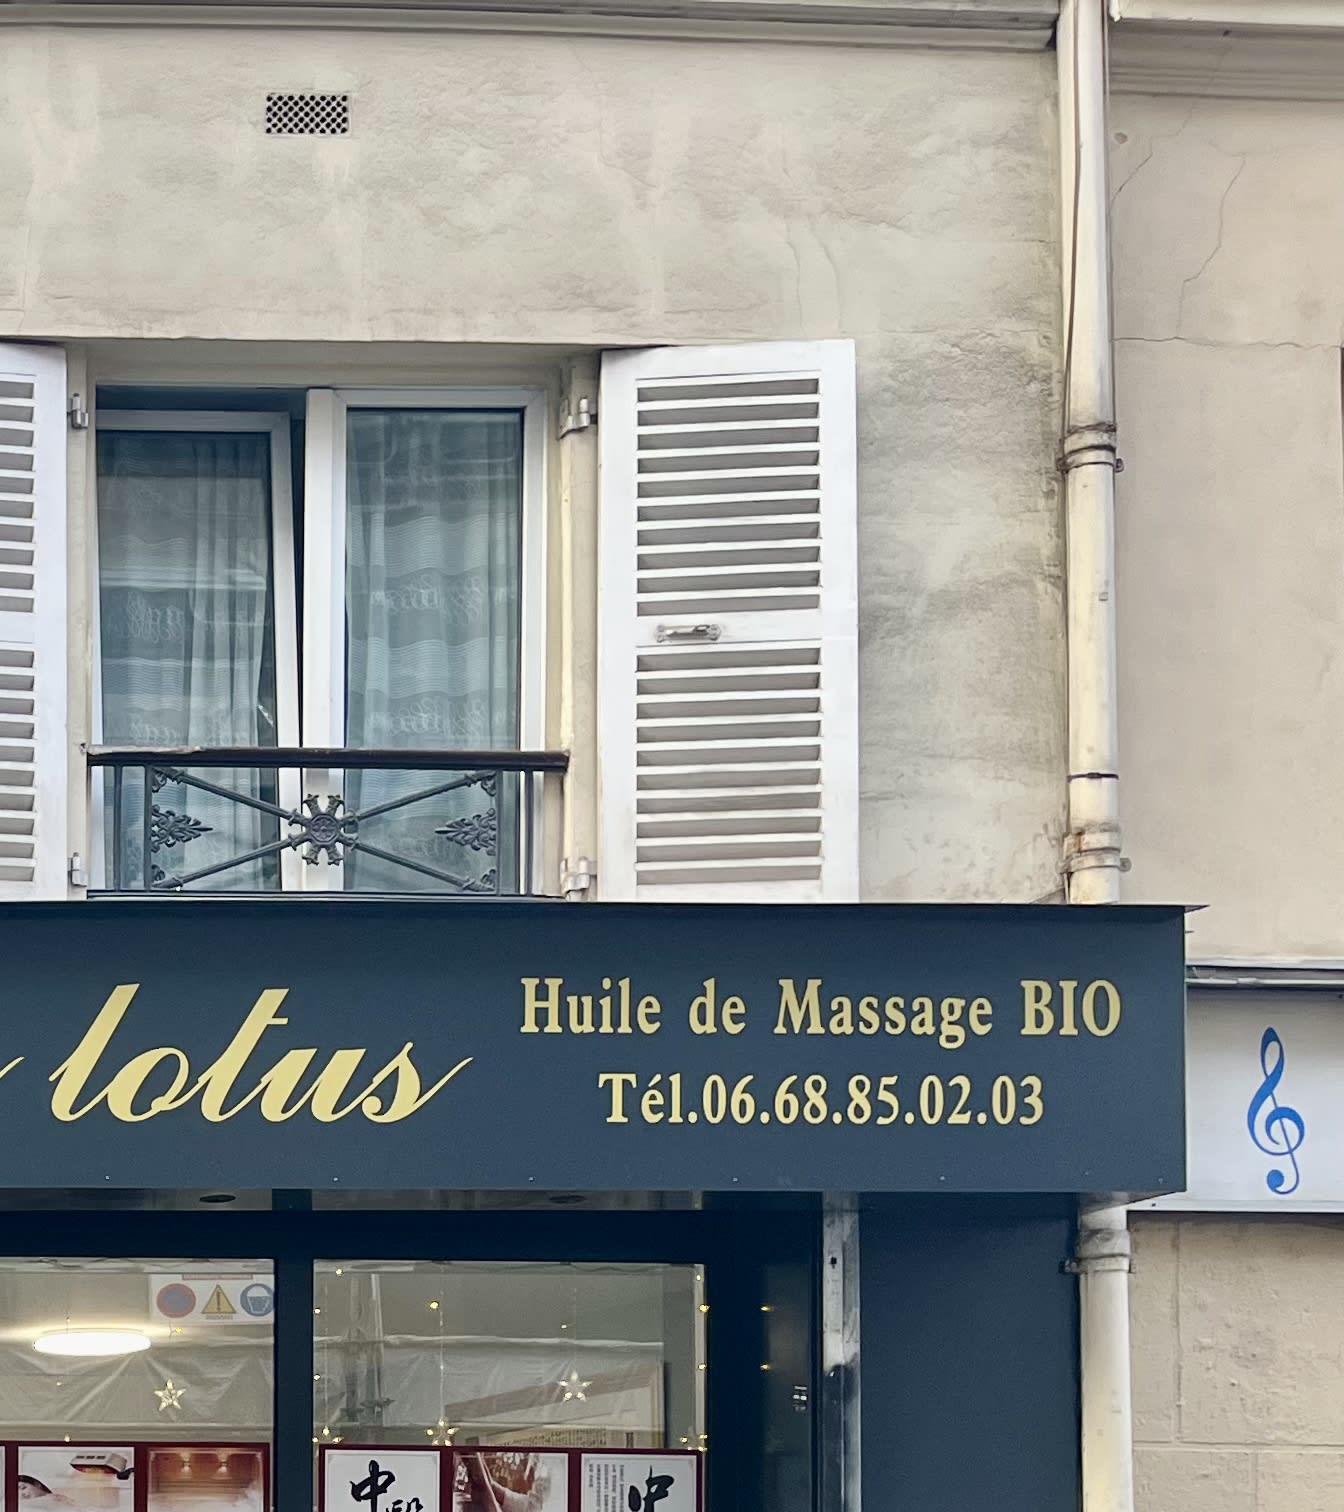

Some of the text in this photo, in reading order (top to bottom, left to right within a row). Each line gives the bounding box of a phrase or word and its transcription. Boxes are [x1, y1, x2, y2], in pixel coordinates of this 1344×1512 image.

[520, 977, 1123, 1050] Huile de Massage BIO
[48, 983, 474, 1124] lotus
[598, 1072, 1045, 1126] Tél.06.68.85.02.03
